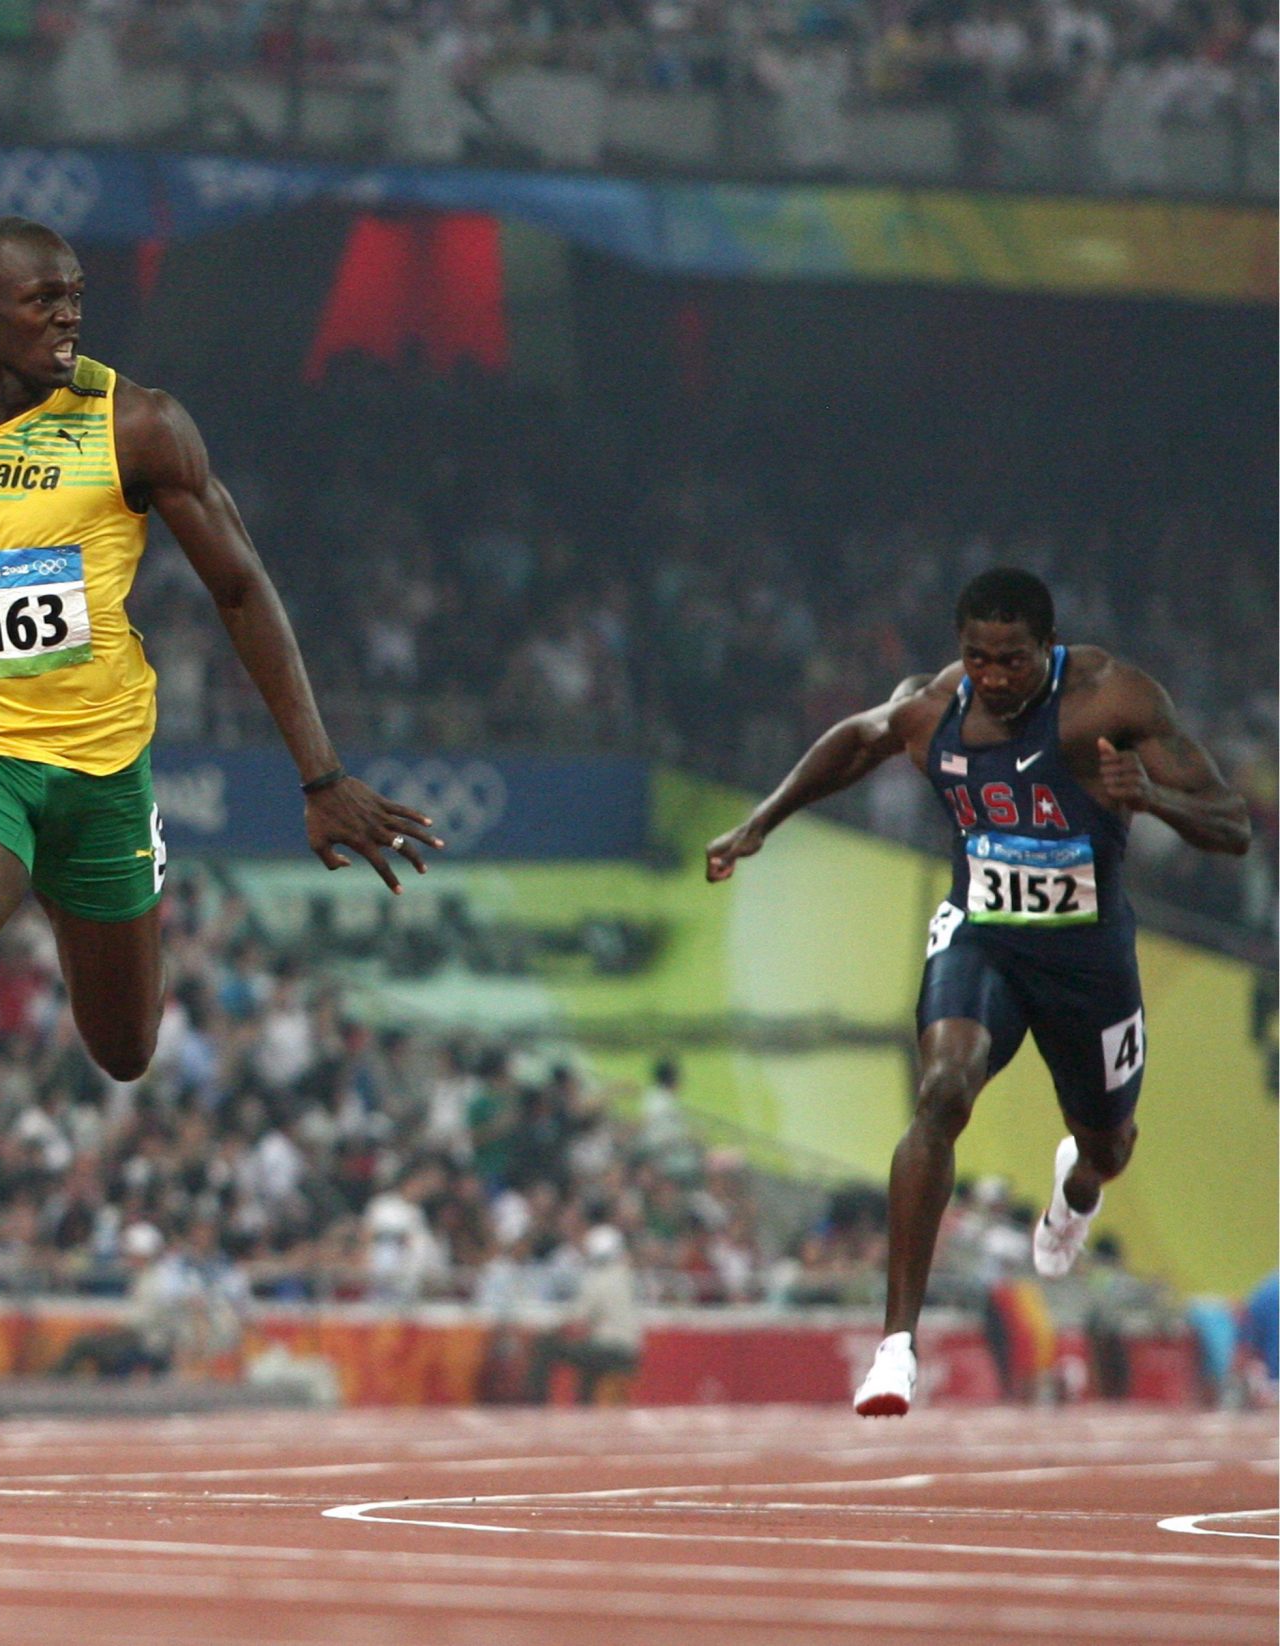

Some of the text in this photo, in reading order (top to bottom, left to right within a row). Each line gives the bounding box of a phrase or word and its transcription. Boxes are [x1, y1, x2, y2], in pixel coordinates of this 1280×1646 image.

[945, 781, 1069, 831] USA
[983, 868, 1079, 912] 3152
[1114, 1022, 1139, 1071] 4
